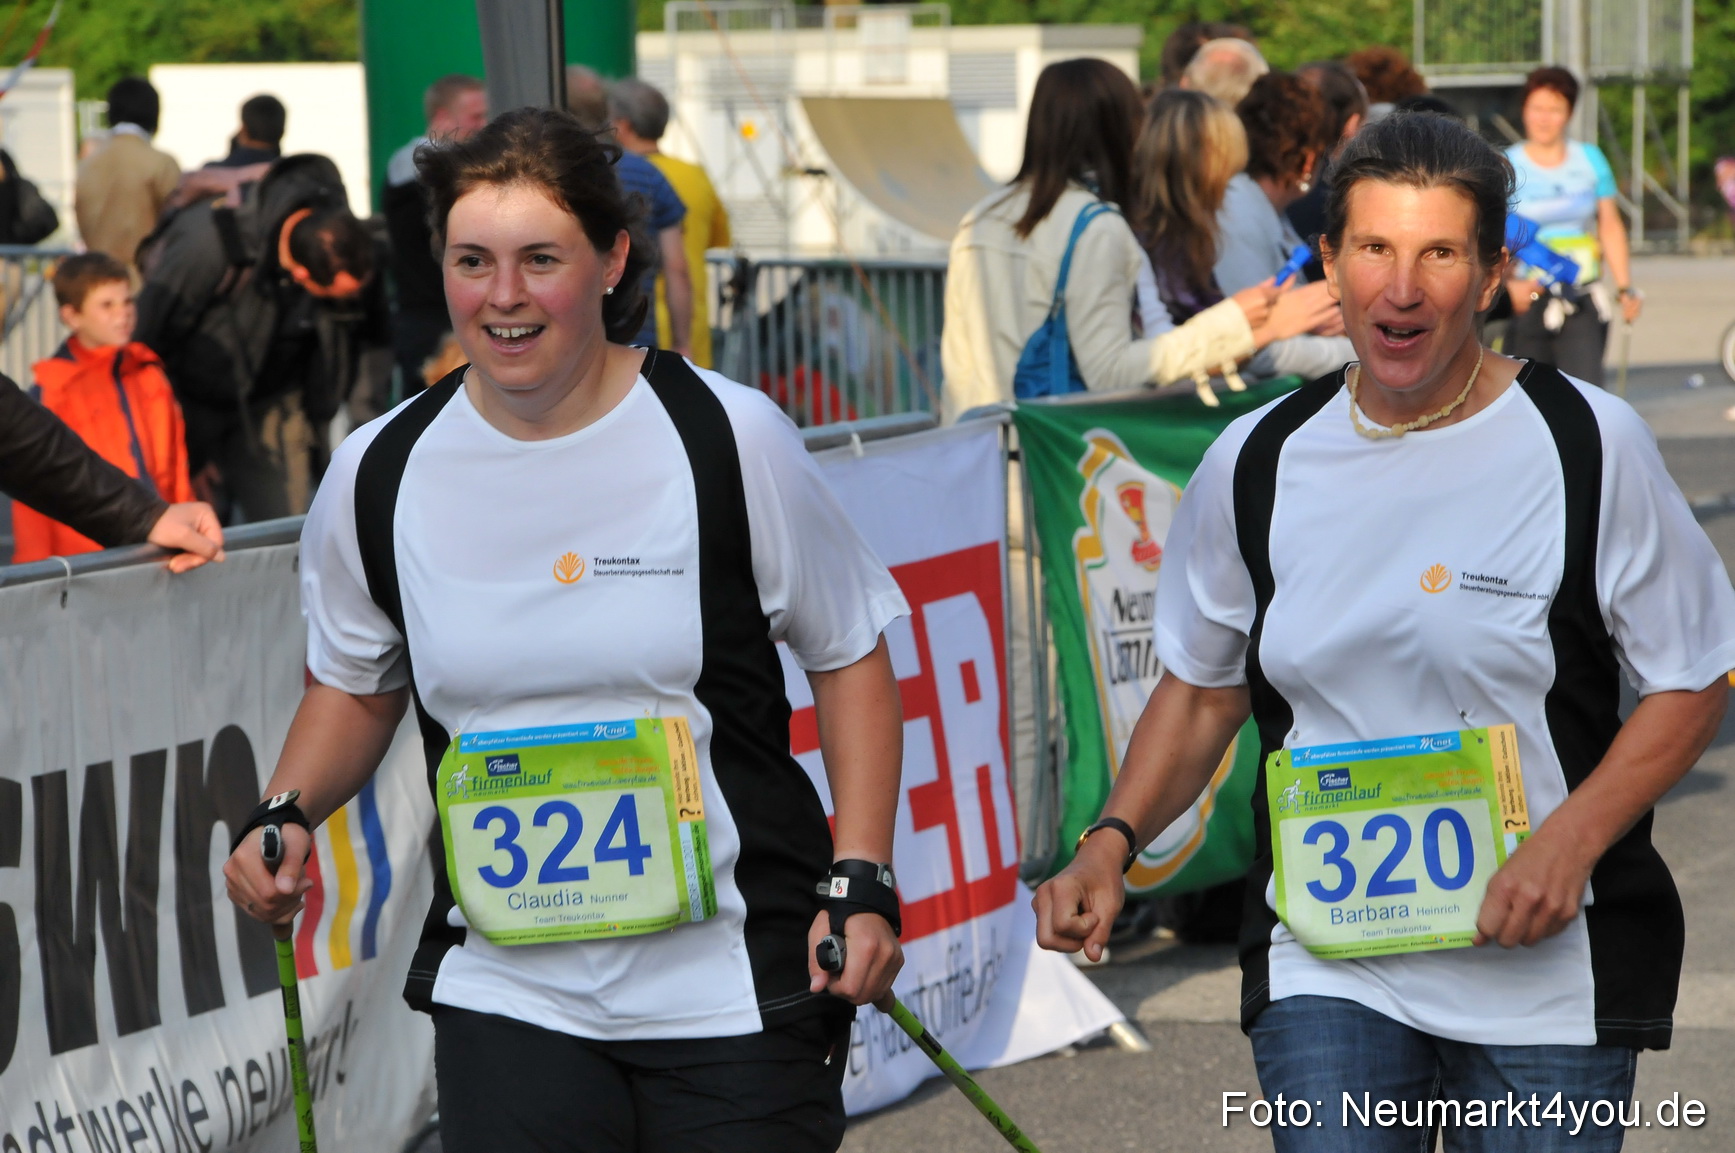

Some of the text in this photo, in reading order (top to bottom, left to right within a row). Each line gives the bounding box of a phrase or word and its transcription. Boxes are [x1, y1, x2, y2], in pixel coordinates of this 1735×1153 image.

[593, 556, 641, 566] Treukontax
[593, 568, 671, 577] Steuerberatungsgesellschaft
[1461, 571, 1509, 586] Treukontax
[1459, 583, 1537, 600] Steuerberatungsgesellschaft
[472, 770, 553, 792] firmenlauf
[1303, 783, 1383, 805] firmenlauf
[679, 806, 701, 818] ?
[1504, 818, 1526, 829] ?
[472, 793, 652, 889] 324
[1302, 807, 1475, 904] 320
[0, 724, 289, 1078] wn
[507, 889, 629, 910] Claudia Nunner
[534, 911, 606, 925] Team Treukontax
[1330, 904, 1460, 925] Barbara Heinrich
[1361, 924, 1432, 938] Team Treukontax
